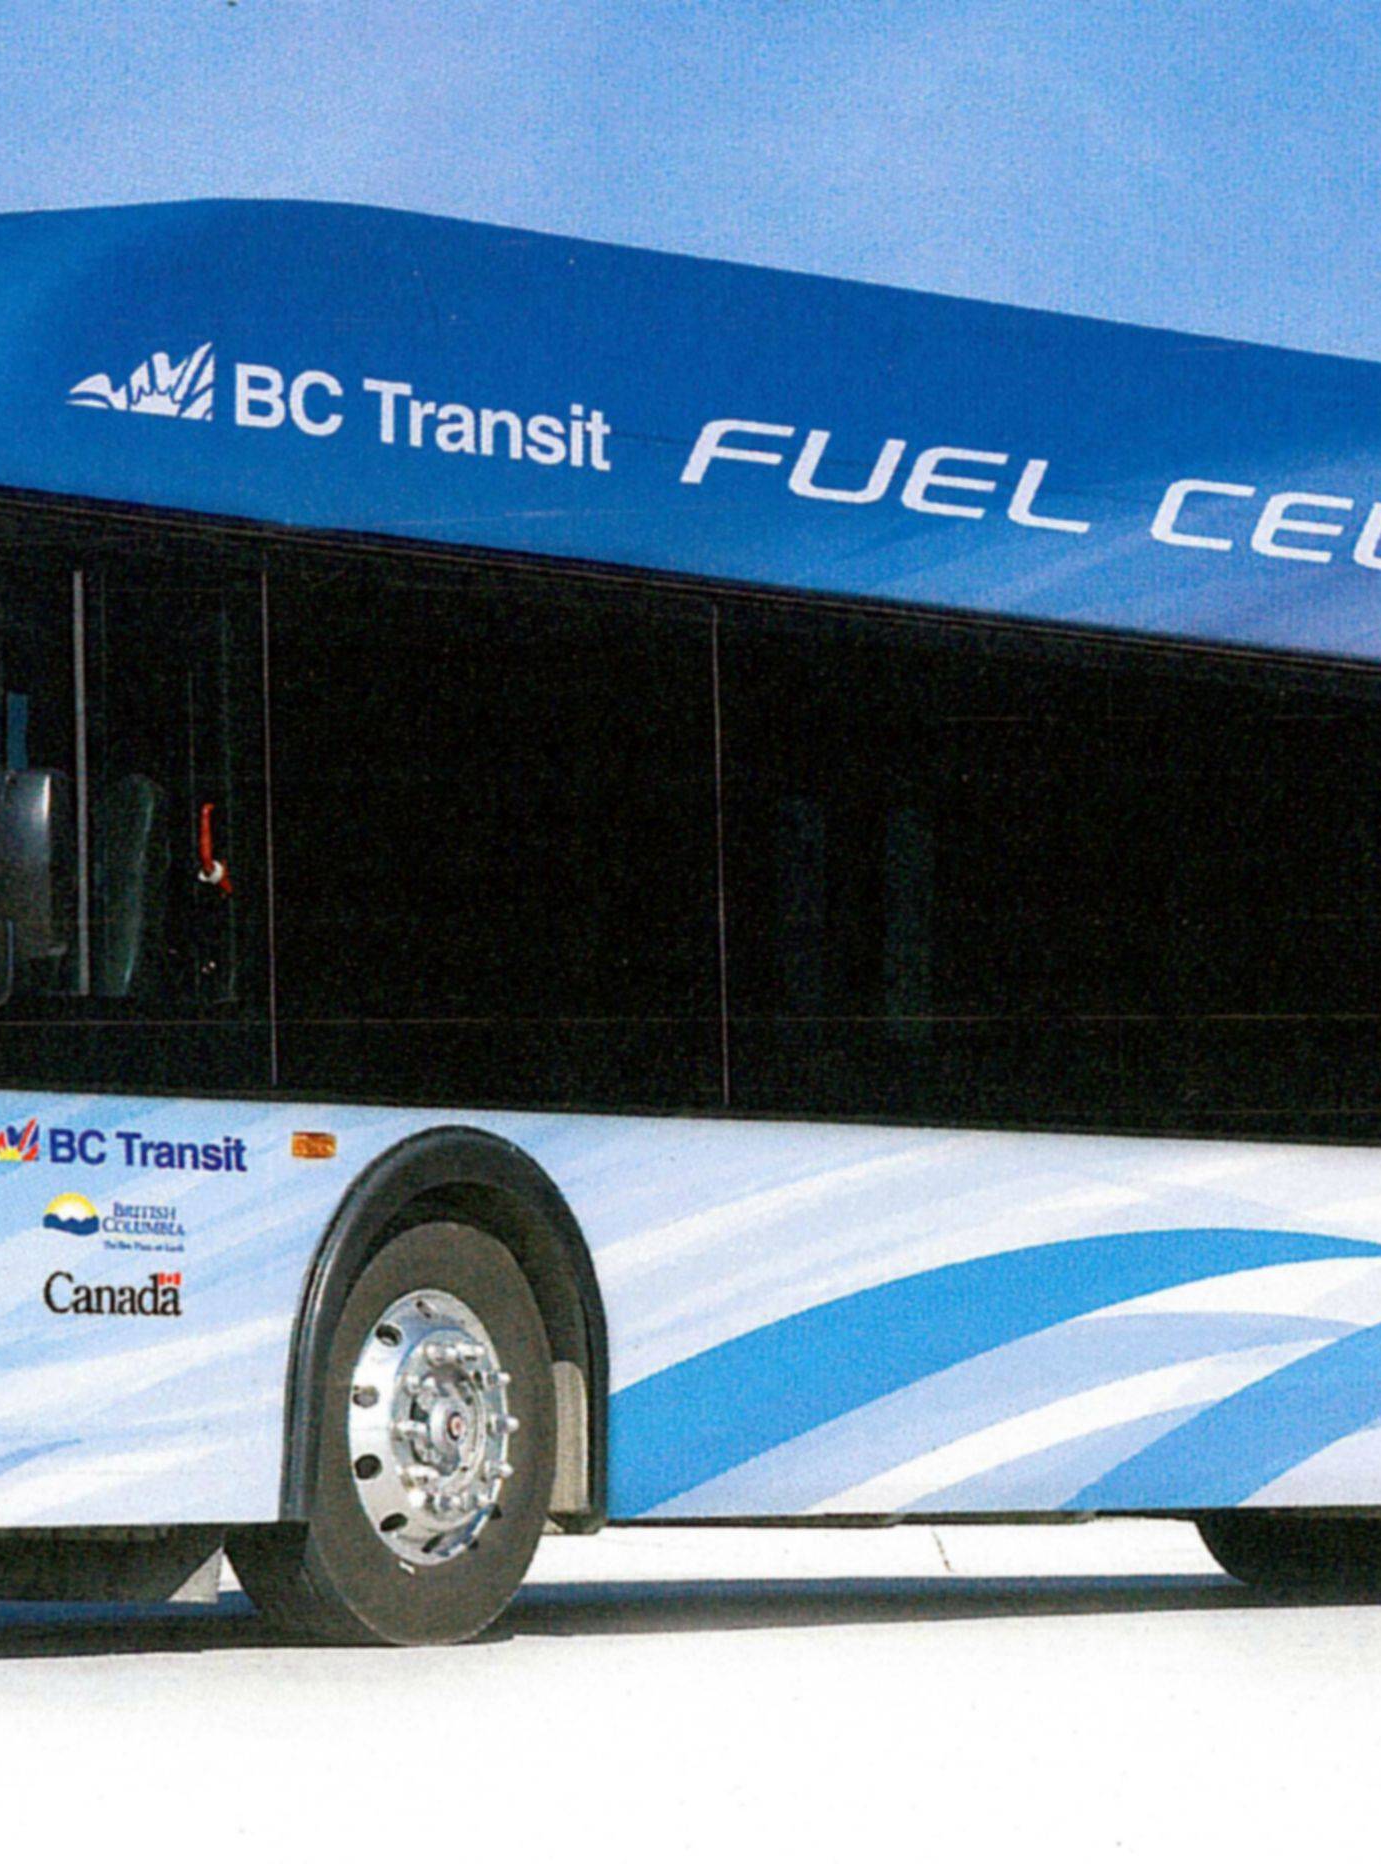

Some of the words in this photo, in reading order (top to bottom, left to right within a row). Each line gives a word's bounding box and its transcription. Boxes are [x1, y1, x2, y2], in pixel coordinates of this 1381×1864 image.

[235, 363, 343, 436] BC
[363, 378, 611, 471] Transit
[680, 418, 1090, 534] FUEL
[48, 1127, 107, 1166] BC
[115, 1130, 248, 1173] Transit
[43, 1271, 182, 1318] Canada
